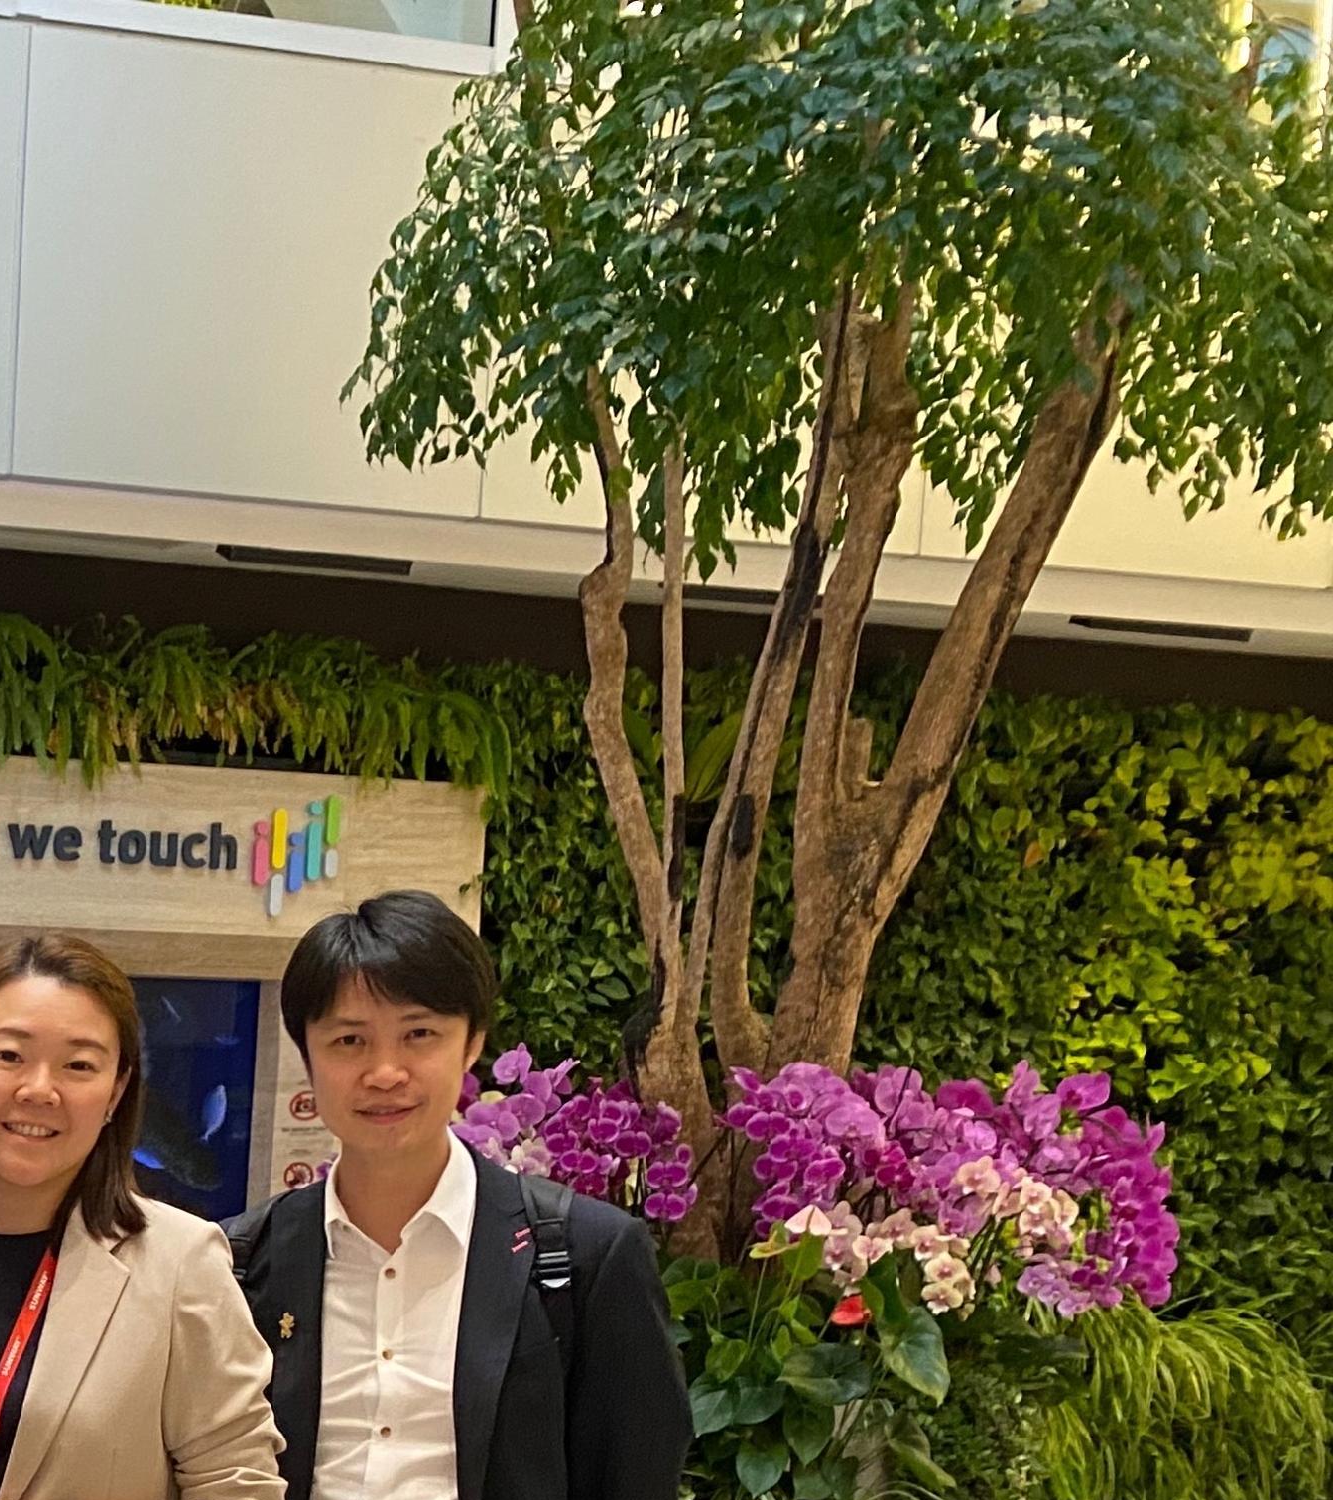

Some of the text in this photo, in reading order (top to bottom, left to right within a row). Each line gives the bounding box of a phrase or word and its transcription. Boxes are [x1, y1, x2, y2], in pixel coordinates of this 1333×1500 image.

[7, 822, 83, 861] we
[98, 819, 238, 871] touch
[28, 1271, 48, 1311] SUNWAY
